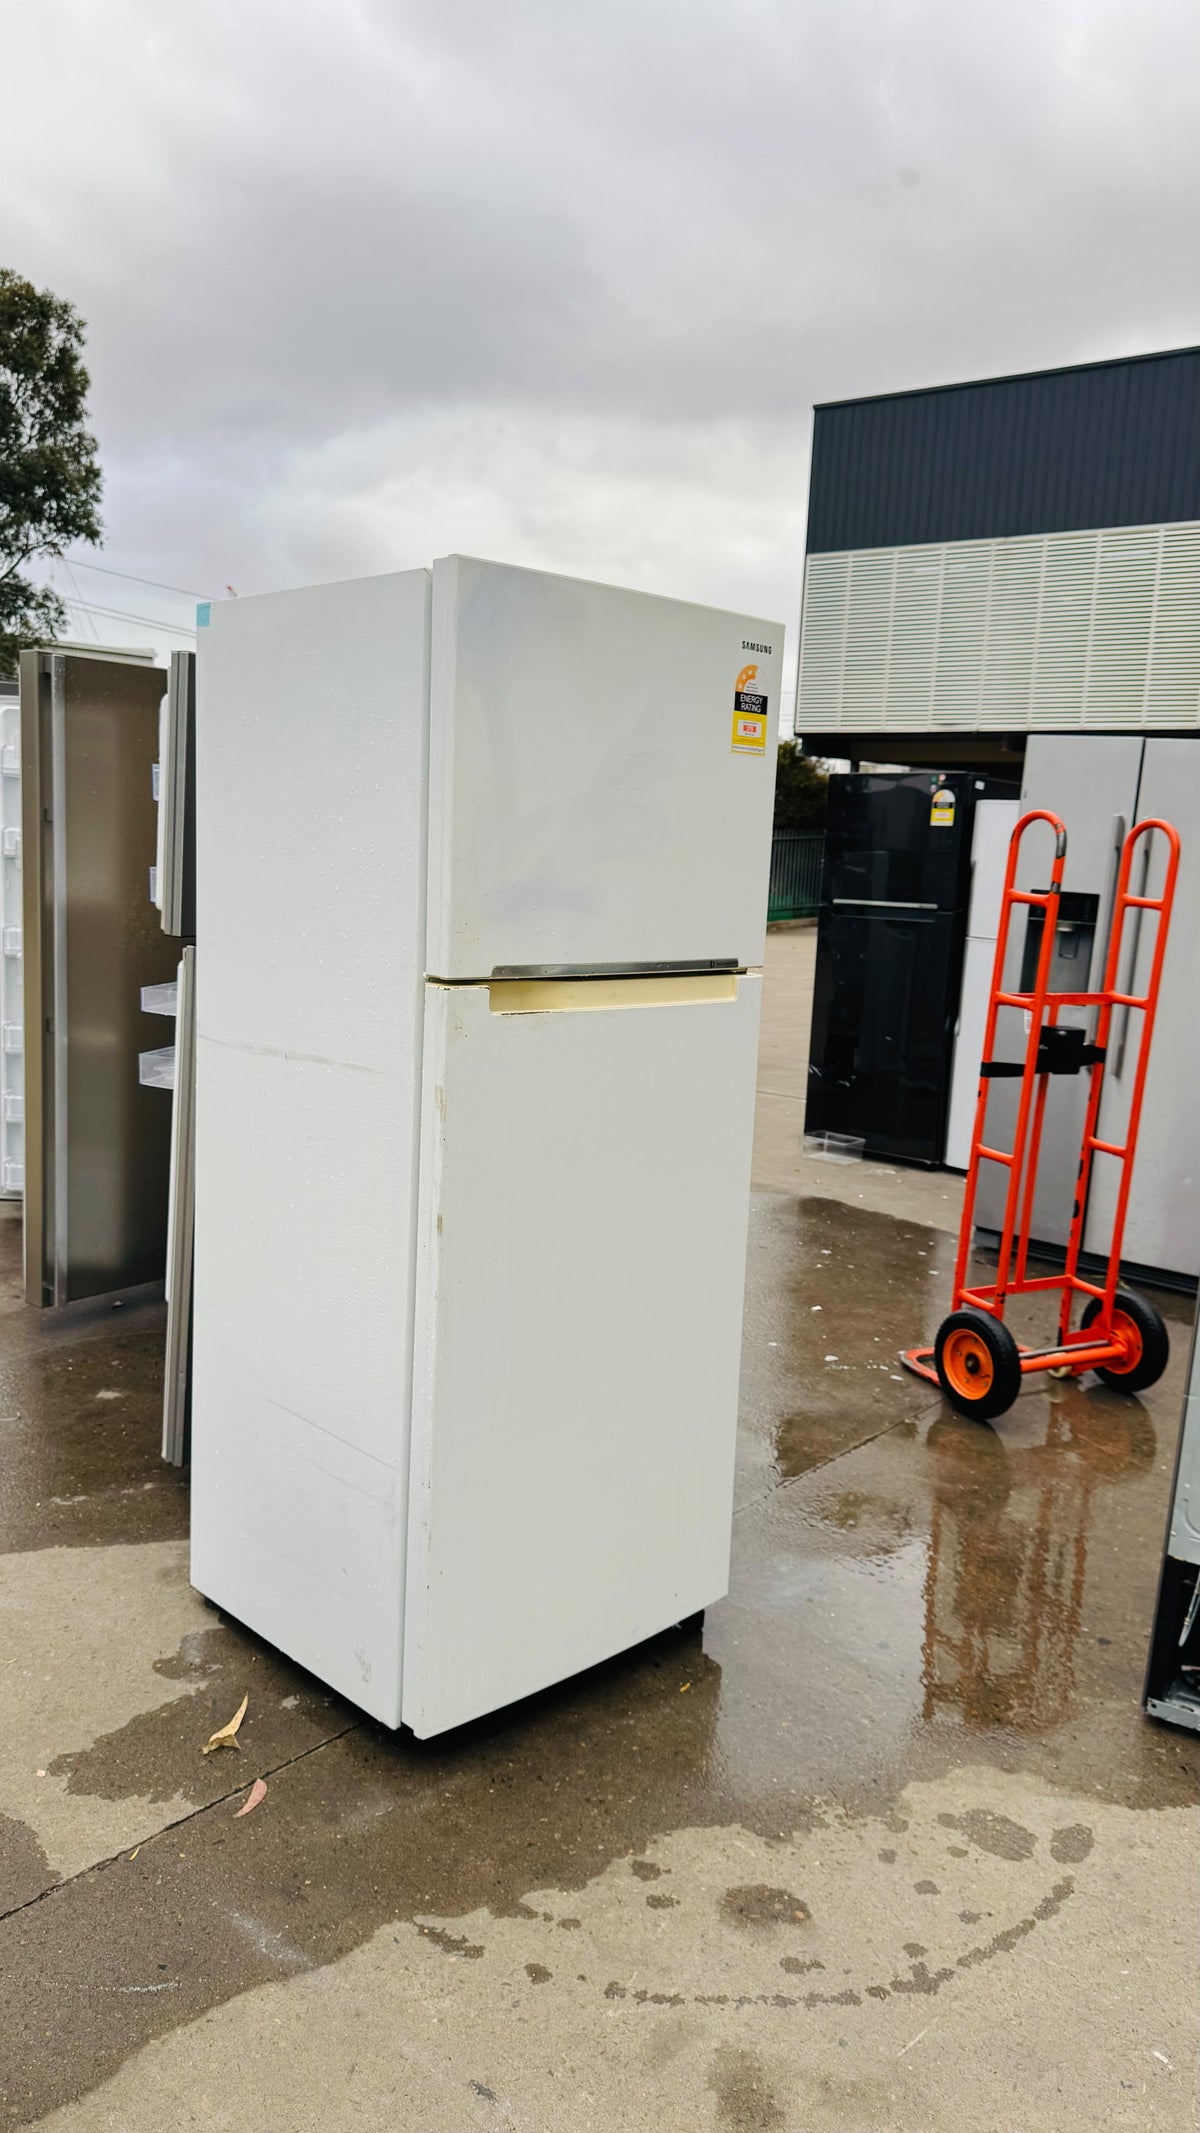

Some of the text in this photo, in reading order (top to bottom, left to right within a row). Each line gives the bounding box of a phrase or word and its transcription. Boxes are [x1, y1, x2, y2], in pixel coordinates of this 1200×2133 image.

[742, 640, 772, 655] SAMSUNG
[740, 694, 763, 705] ENERGY
[740, 702, 761, 713] RATING
